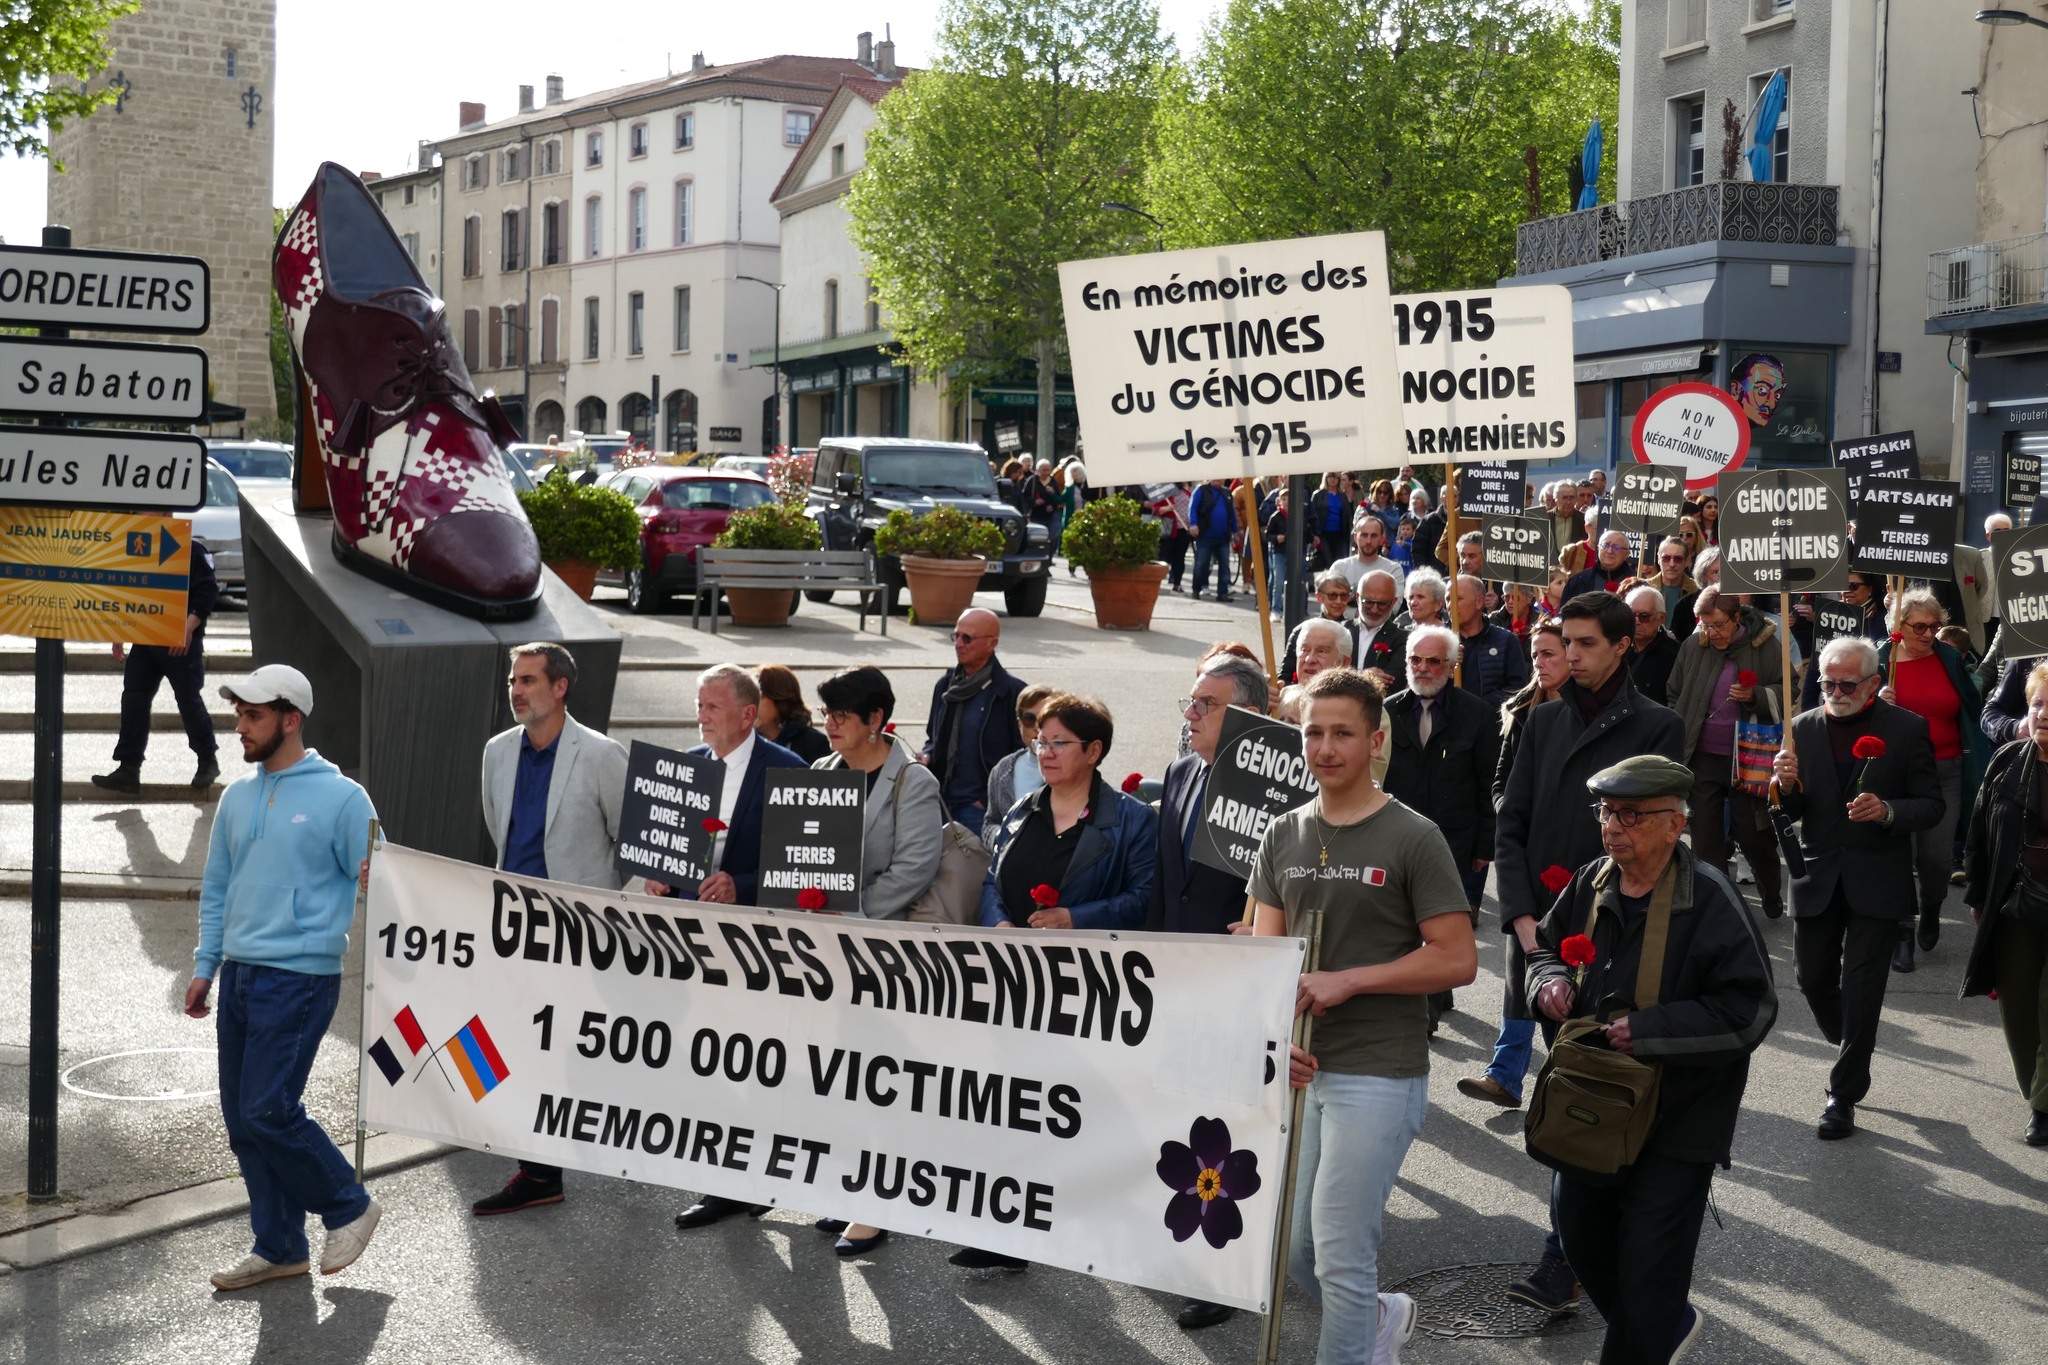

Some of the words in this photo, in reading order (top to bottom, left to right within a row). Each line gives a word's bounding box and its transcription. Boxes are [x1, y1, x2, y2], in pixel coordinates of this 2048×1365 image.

[1082, 281, 1121, 311] En
[1134, 267, 1288, 307] mémoire
[1301, 260, 1367, 292] des
[1394, 297, 1495, 346] 1915
[1134, 314, 1325, 365] VICTIMES
[1641, 357, 1692, 371] CONTEMPORAINE
[18, 360, 192, 401] Sabaton
[1111, 383, 1155, 415] du
[1169, 365, 1366, 411] GÉNOCIDE
[1681, 408, 1715, 427] NON
[1170, 428, 1219, 461] de
[1234, 421, 1312, 457] 1915
[1683, 426, 1702, 440] AU
[1644, 432, 1729, 466] NÉGATIONNISME
[1839, 439, 1911, 460] ARTSAKH
[102, 454, 193, 490] Nadi
[1468, 469, 1502, 479] POURRA
[1504, 471, 1520, 480] PAS
[2011, 458, 2039, 471] STOP
[1481, 482, 1501, 491] DIRE
[1623, 475, 1677, 492] STOP
[2017, 473, 2040, 482] MASSACRE
[1483, 493, 1496, 502] ON
[1497, 494, 1509, 502] NE
[1616, 496, 1678, 518] NÉGATIONNISME
[1737, 484, 1827, 514] GÉNOCIDE
[1864, 489, 1953, 507] ARTSAKH
[1463, 503, 1493, 513] SAVAIT
[1494, 505, 1510, 514] PAS
[1772, 517, 1793, 526] des
[6, 525, 47, 538] JEAN
[52, 528, 112, 543] JAURÈS
[1490, 525, 1541, 544] STOP
[1881, 531, 1929, 545] TERRES
[1727, 532, 1840, 562] ARMÉNIENS
[1858, 546, 1948, 565] ARMÉNIENNES
[1486, 547, 1544, 569] NÉGATIONNISME
[25, 567, 46, 577] DU
[59, 570, 149, 584] DAUPHINÉ
[1753, 569, 1781, 581] 1915
[6, 593, 68, 610] ENTRÉE
[73, 599, 120, 612] JULES
[125, 602, 164, 615] NADI
[1820, 612, 1857, 632] STOP
[656, 759, 675, 778] ON
[676, 764, 694, 784] NE
[1236, 737, 1319, 793] GÉNOCID
[634, 777, 683, 803] POURRA
[685, 791, 710, 812] PAS
[769, 787, 858, 806] ARTSAKH
[1265, 787, 1288, 803] des
[649, 805, 678, 827] DIRE
[650, 829, 670, 848] ON
[671, 834, 689, 853] NE
[620, 843, 662, 870] SAVAIT
[663, 856, 687, 877] PAS
[785, 846, 835, 864] TERRES
[763, 870, 855, 891] ARMÉNIENNES
[378, 922, 475, 969] 1915
[491, 879, 728, 987] GENOCIDE
[718, 922, 834, 1001] DES
[837, 933, 1155, 1047] ARMENIENS
[533, 1005, 555, 1052] 1
[576, 1010, 672, 1069] 500
[690, 1028, 787, 1088] 000
[807, 1044, 1082, 1139] VICTIMES
[533, 1093, 755, 1172] MEMOIRE
[765, 1133, 830, 1184] ET
[841, 1149, 1054, 1232] JUSTICE
